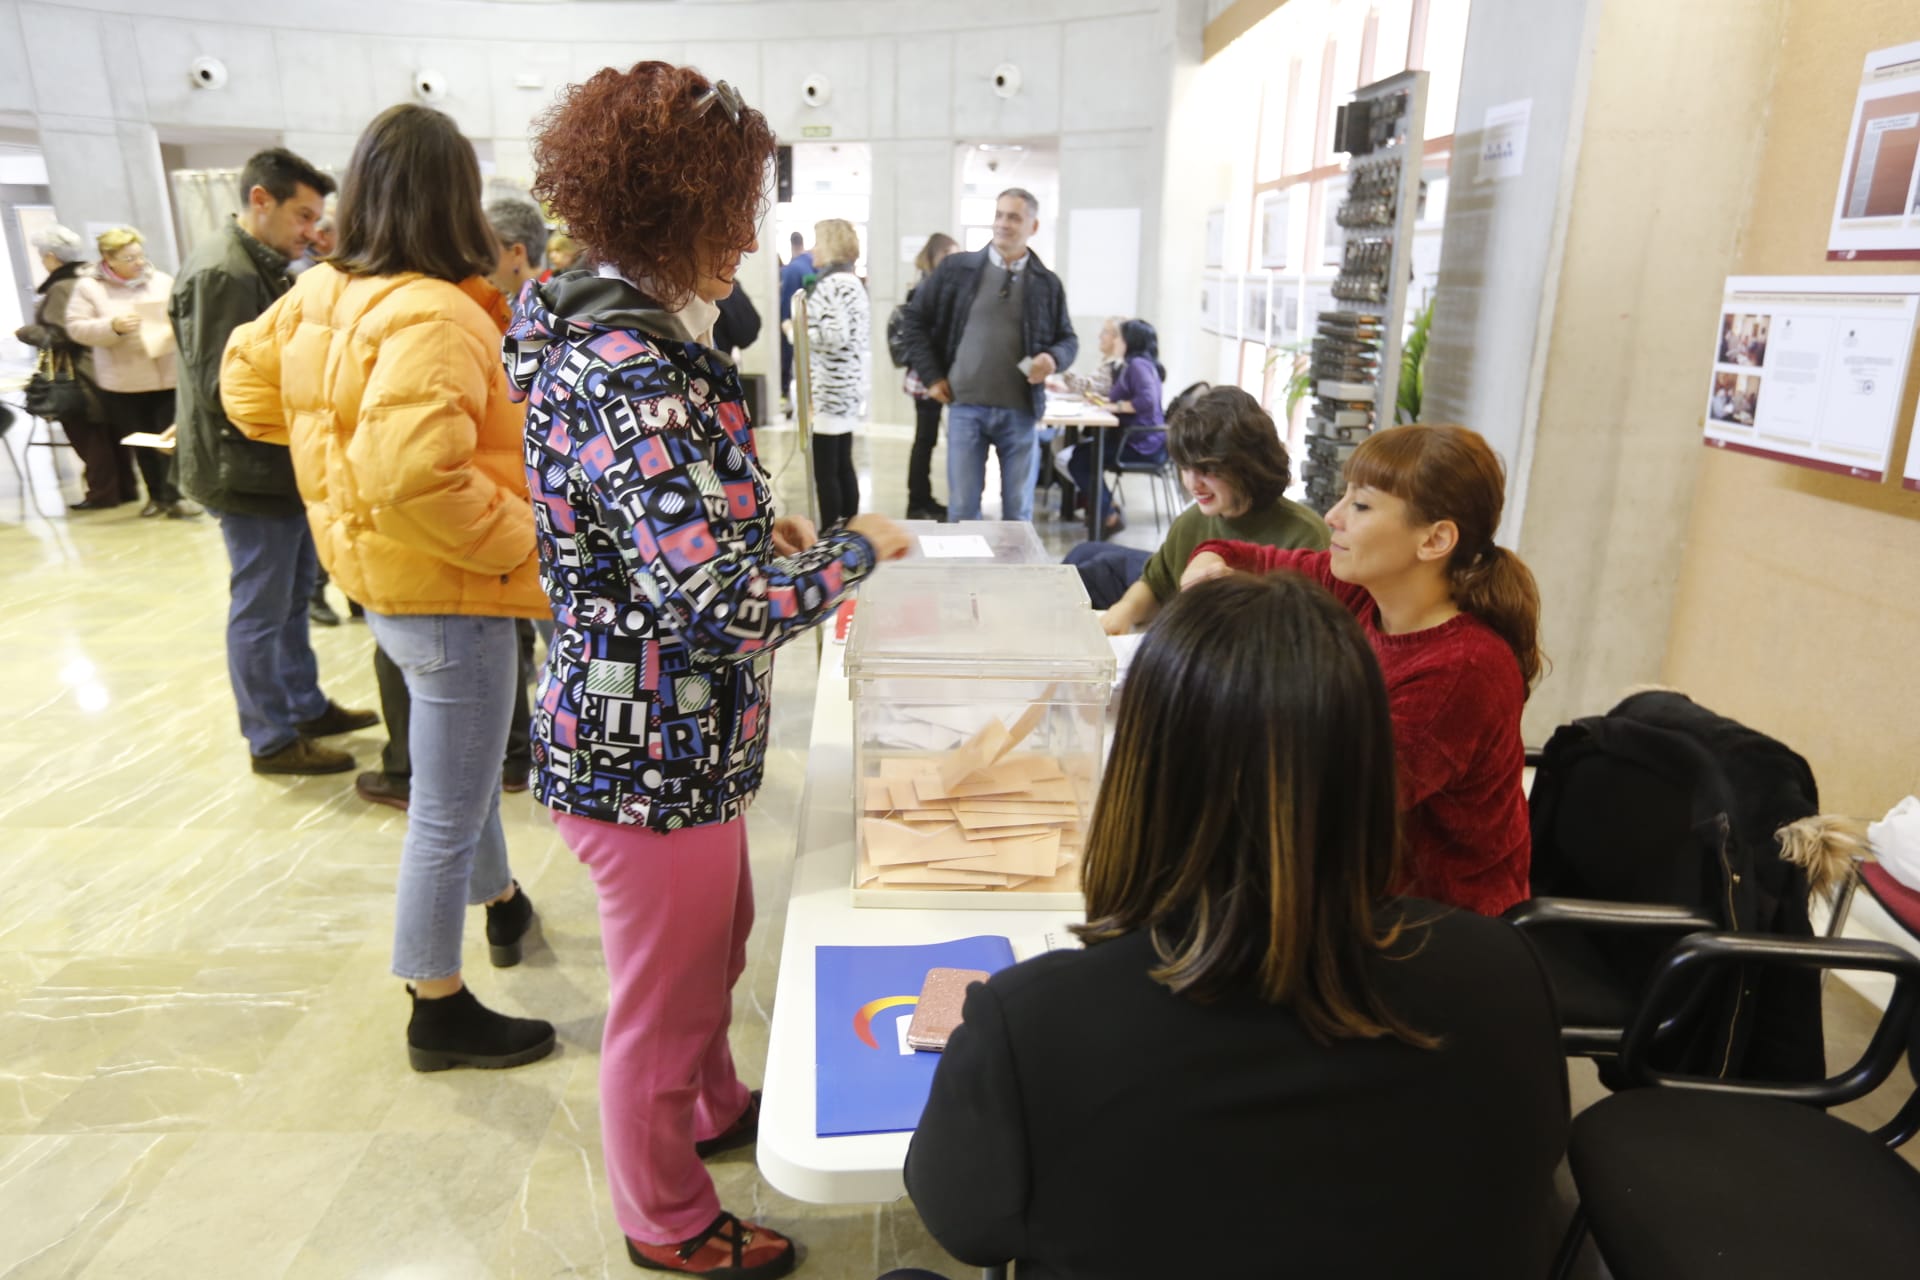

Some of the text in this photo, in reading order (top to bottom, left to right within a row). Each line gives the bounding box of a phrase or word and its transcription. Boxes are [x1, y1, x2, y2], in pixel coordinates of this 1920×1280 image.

[602, 398, 637, 445] E
[639, 396, 687, 428] S
[669, 722, 699, 759] R
